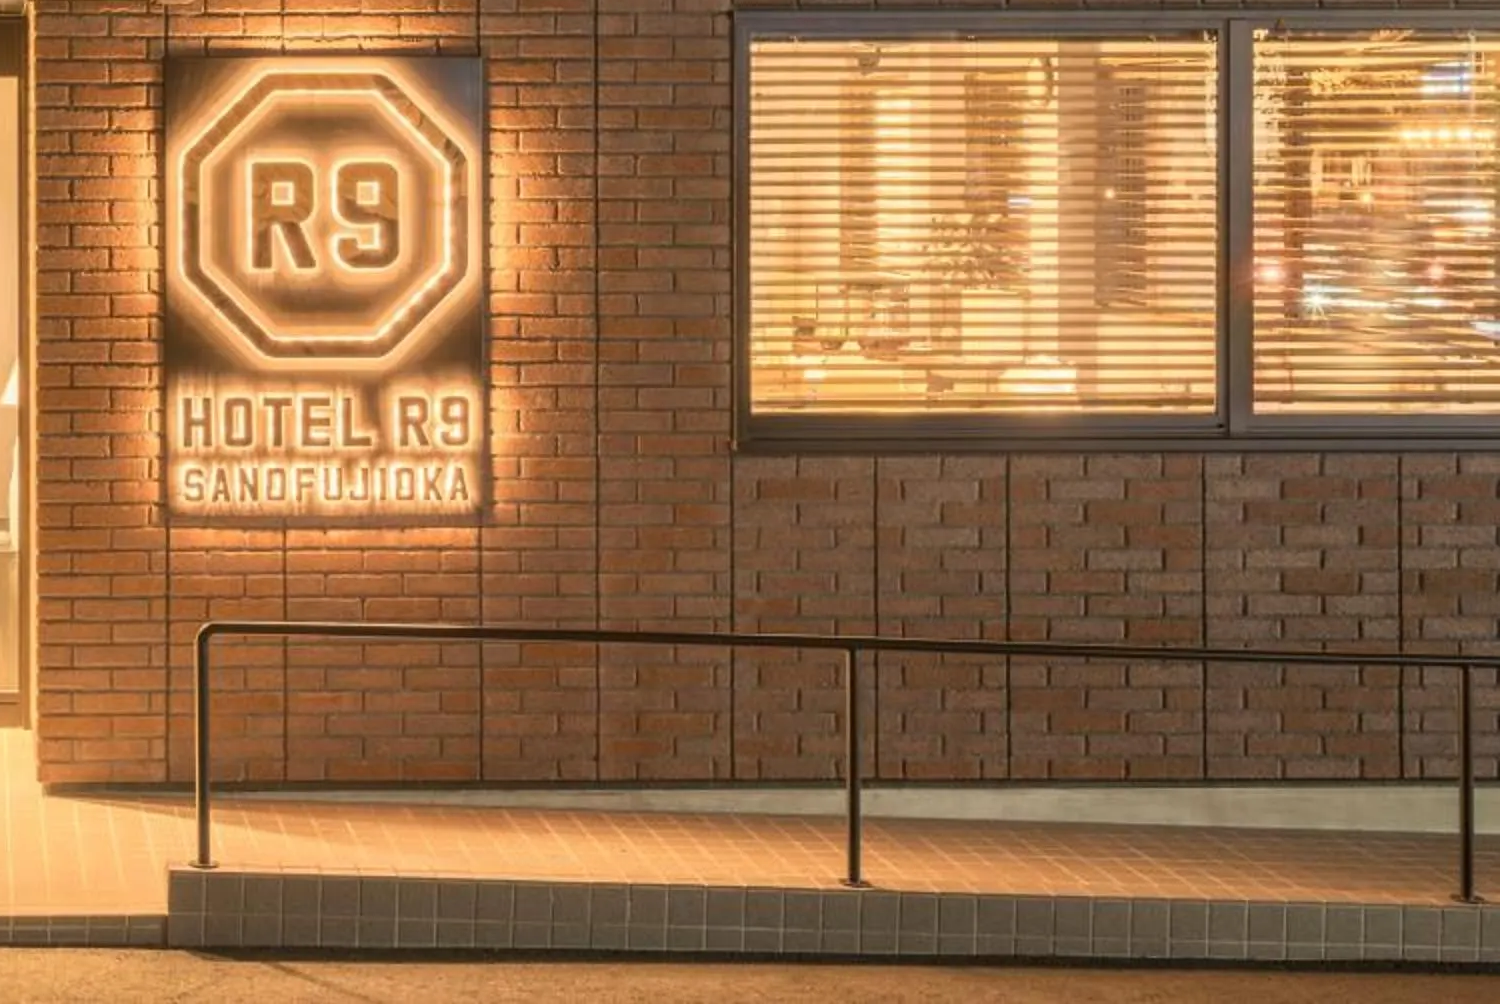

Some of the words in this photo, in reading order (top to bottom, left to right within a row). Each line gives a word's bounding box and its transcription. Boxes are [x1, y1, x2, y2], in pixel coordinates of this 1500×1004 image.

[250, 160, 401, 270] R9
[182, 396, 373, 447] HOTEL
[398, 395, 470, 447] R9
[183, 466, 470, 503] SANOFUJIOKA
